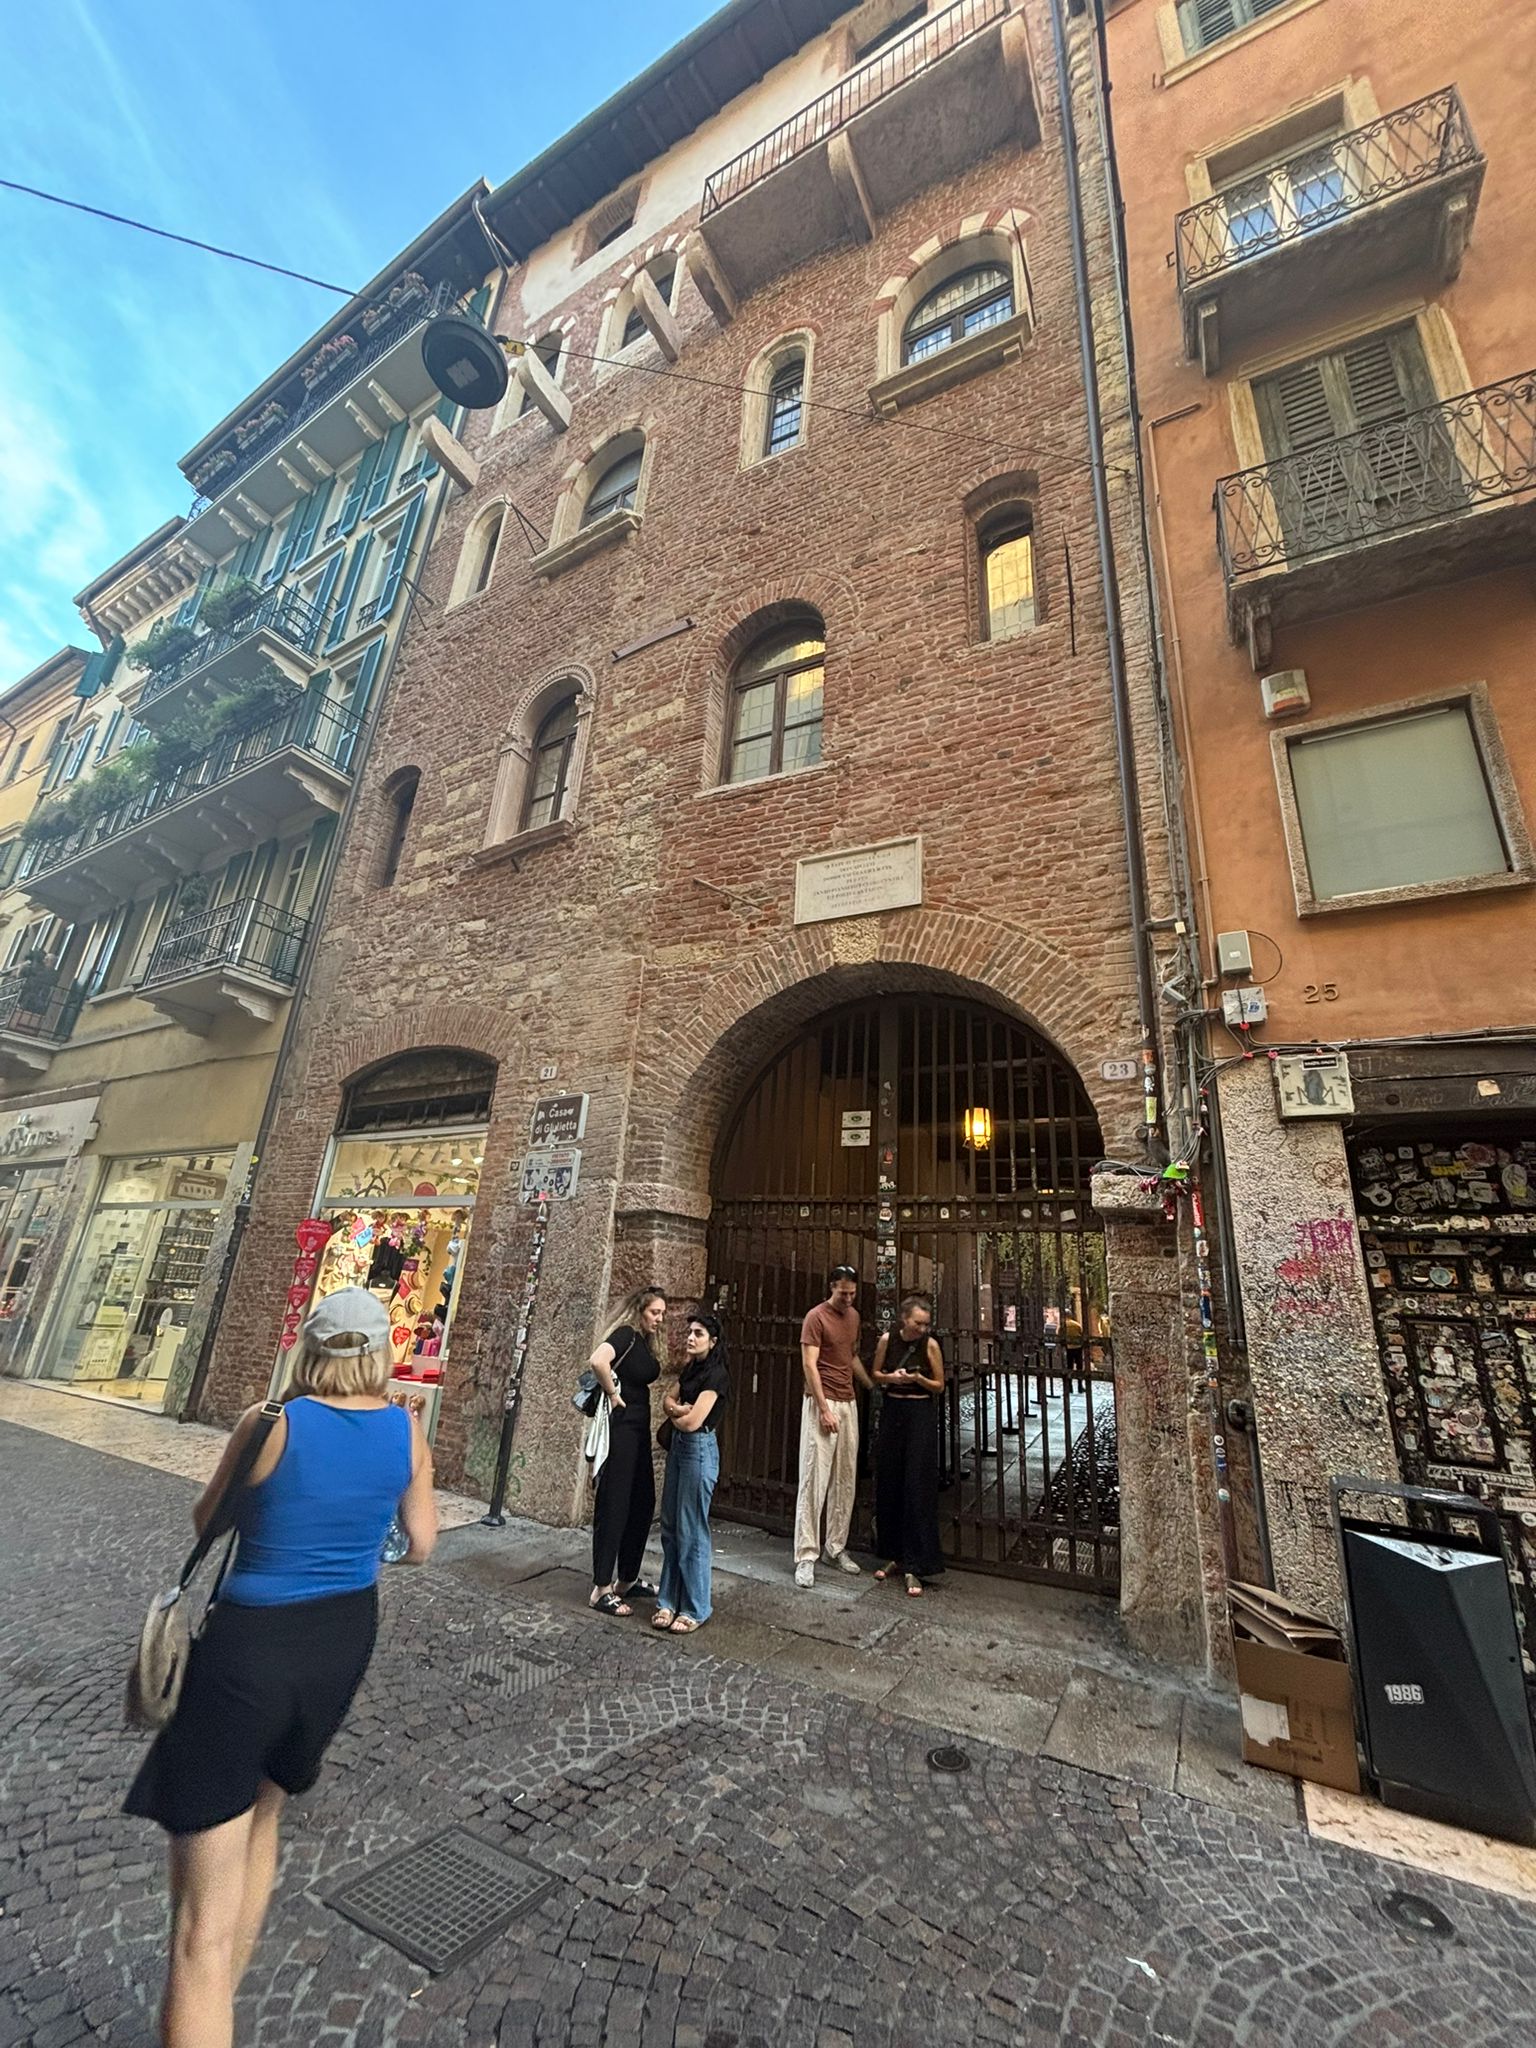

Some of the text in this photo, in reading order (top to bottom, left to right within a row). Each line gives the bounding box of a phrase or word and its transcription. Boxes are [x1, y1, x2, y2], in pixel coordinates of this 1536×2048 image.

[1304, 983, 1339, 1003] 25
[544, 1068, 553, 1077] 21
[1109, 1063, 1129, 1076] 23
[549, 1108, 567, 1118] Casa
[535, 1121, 577, 1134] di Giulietta
[1384, 1684, 1423, 1704] 1986
